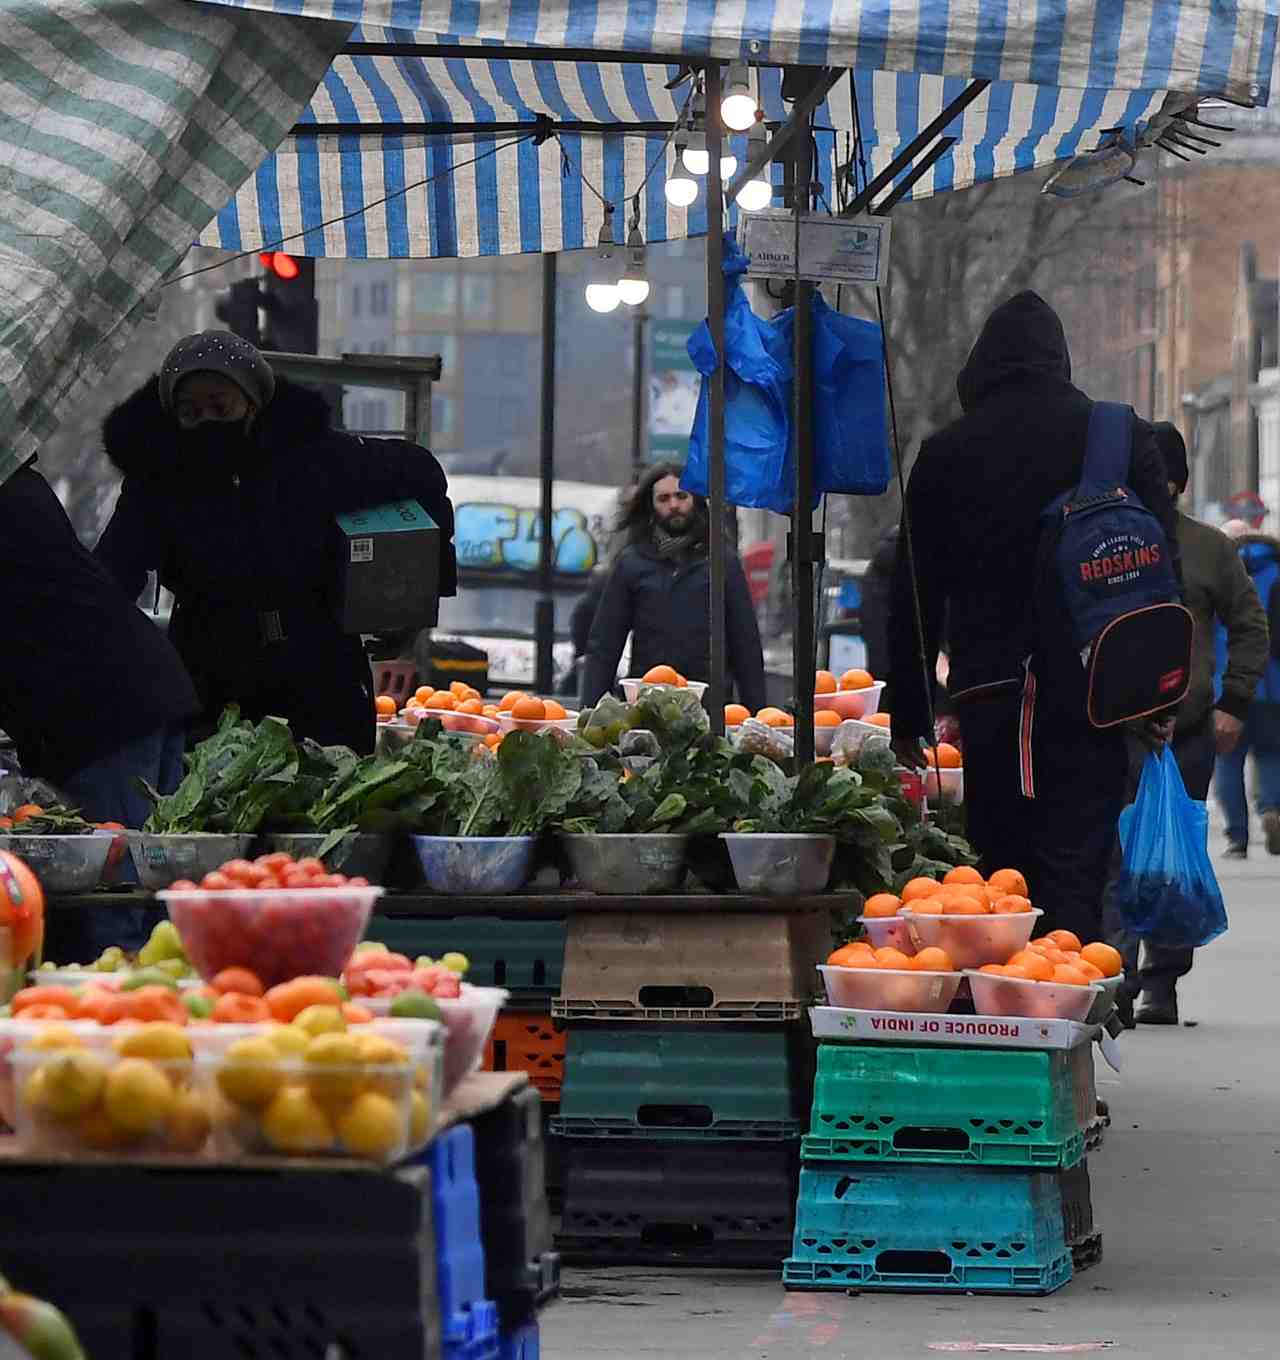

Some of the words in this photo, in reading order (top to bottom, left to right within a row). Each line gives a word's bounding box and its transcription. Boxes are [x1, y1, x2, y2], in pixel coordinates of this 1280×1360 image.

[1080, 543, 1161, 582] REDSKINS
[871, 1018, 914, 1031] INDIA
[920, 1020, 940, 1033] OF
[945, 1021, 1019, 1037] PRODUCE
